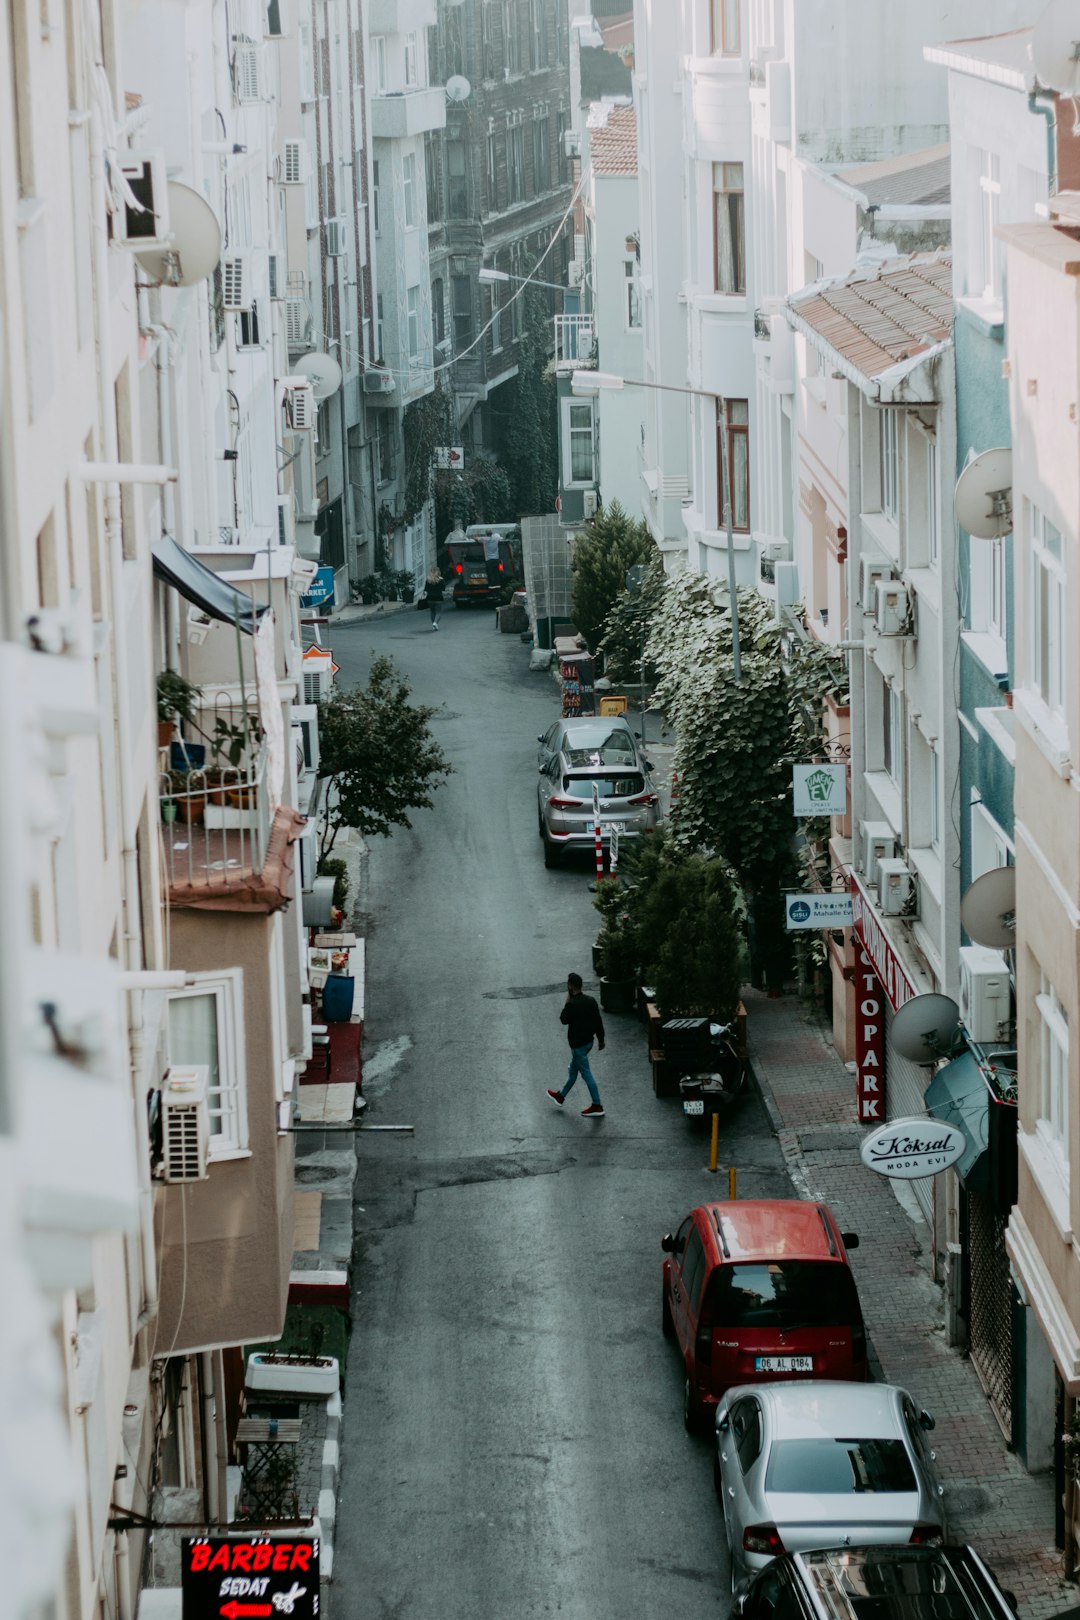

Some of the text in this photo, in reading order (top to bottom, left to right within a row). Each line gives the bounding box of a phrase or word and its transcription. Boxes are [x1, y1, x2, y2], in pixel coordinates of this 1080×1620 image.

[870, 1133, 956, 1156] Köksal
[887, 1156, 947, 1170] MODA EVİ
[761, 1358, 810, 1368] 06 AL 0184
[190, 1543, 313, 1572] BARBER
[219, 1576, 271, 1597] SEDAT
